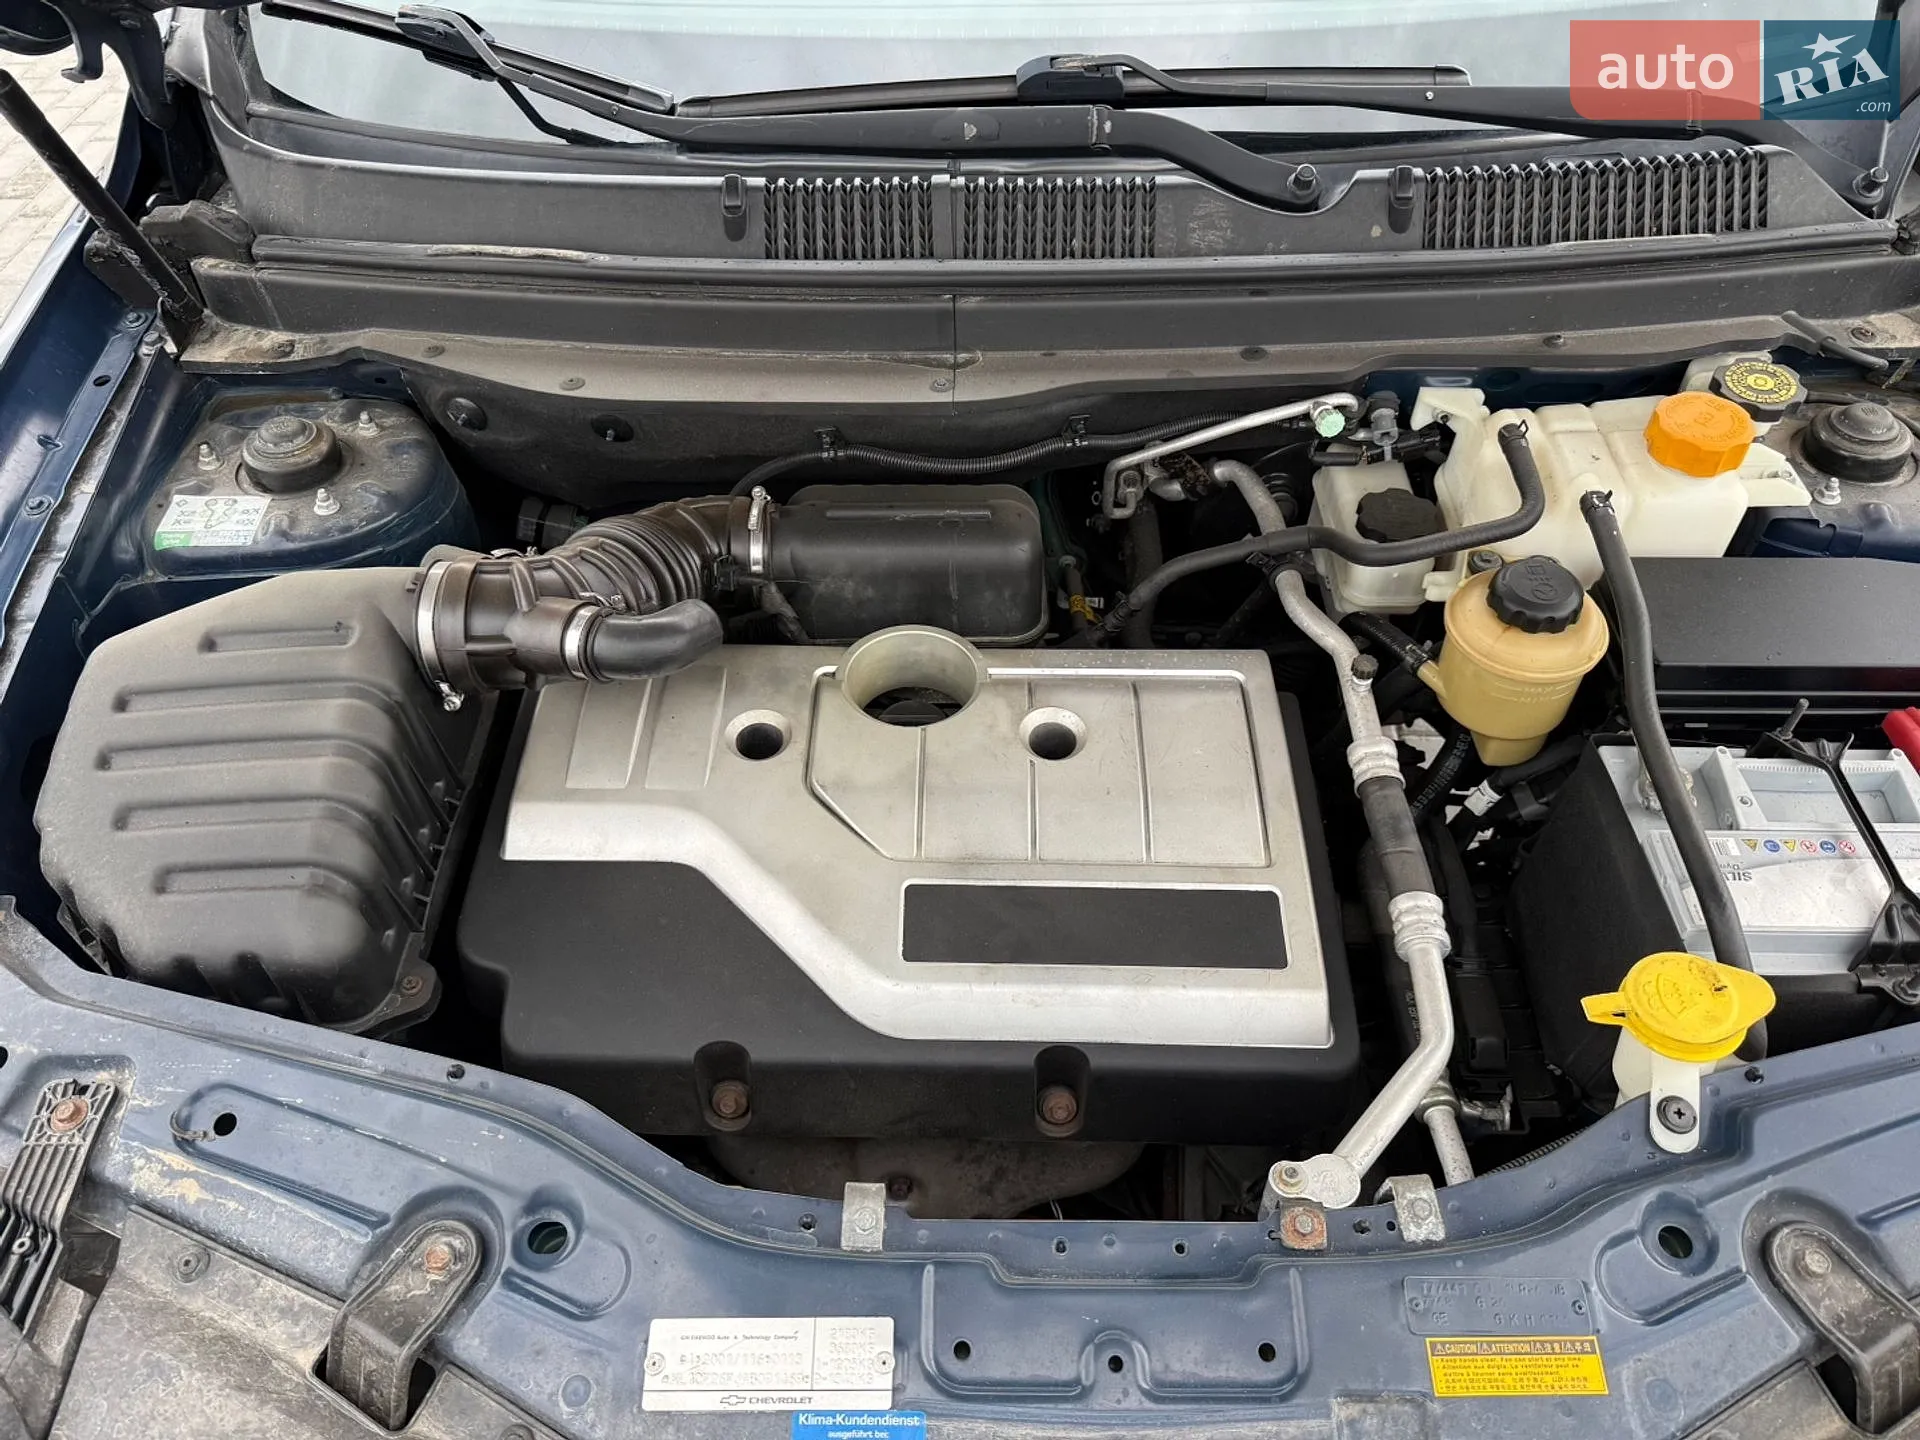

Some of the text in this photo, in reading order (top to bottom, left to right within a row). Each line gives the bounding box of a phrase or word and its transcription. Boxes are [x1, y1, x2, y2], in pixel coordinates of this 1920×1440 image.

[1445, 1343, 1531, 1354] CAUTION ATTENTION
[748, 1396, 814, 1405] CHEVROLET
[798, 1411, 921, 1426] Klima-Kundendienst
